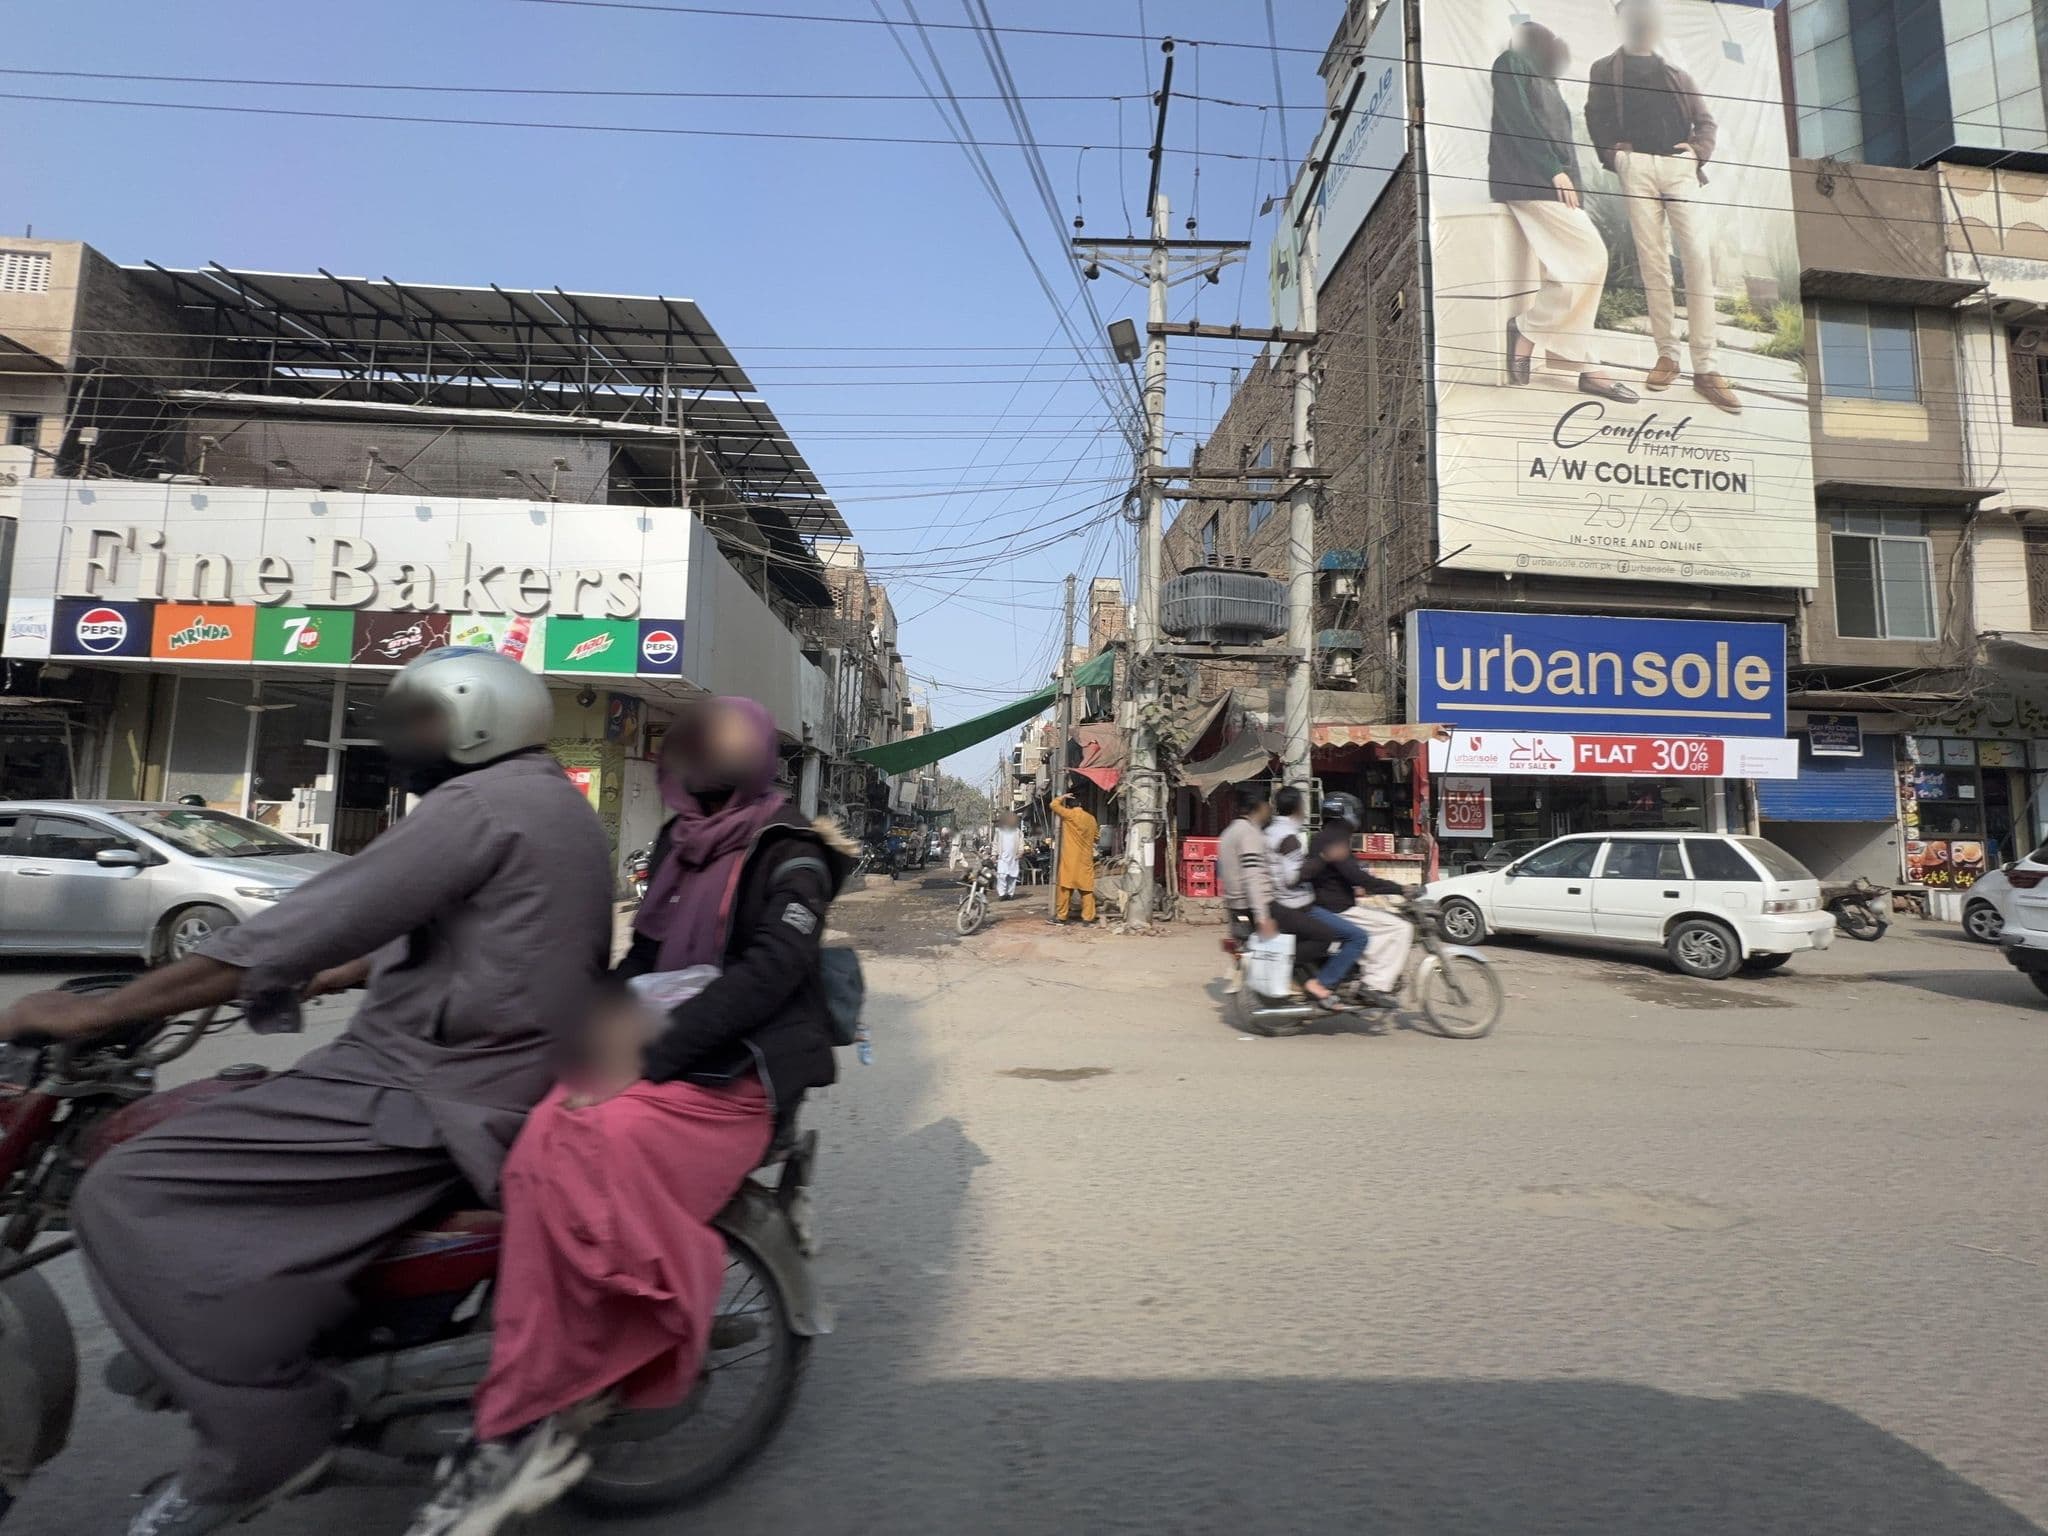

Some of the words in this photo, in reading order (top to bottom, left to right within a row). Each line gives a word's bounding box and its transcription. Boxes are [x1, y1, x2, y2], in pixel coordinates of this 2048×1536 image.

[1553, 401, 1692, 454] Comfort
[1643, 442, 1676, 457] THAT
[1681, 446, 1730, 462] MOVES
[1529, 455, 1587, 480] A/W
[1594, 461, 1747, 493] COLLECTION
[1584, 493, 1692, 533] 25/26
[1570, 535, 1626, 548] IN-STORE
[1631, 538, 1655, 549] AND
[1660, 541, 1702, 552] ONLINE
[81, 625, 123, 636] PEPSI
[169, 617, 232, 651] MIRINDA
[646, 643, 675, 651] PEPSI
[1436, 634, 1772, 701] urbansole
[1580, 743, 1637, 764] FLAT
[1652, 740, 1709, 770] 30%
[1509, 762, 1525, 770] DAY
[1527, 762, 1548, 770] SALE
[1689, 762, 1709, 771] OFF
[1448, 791, 1481, 804] FLAT
